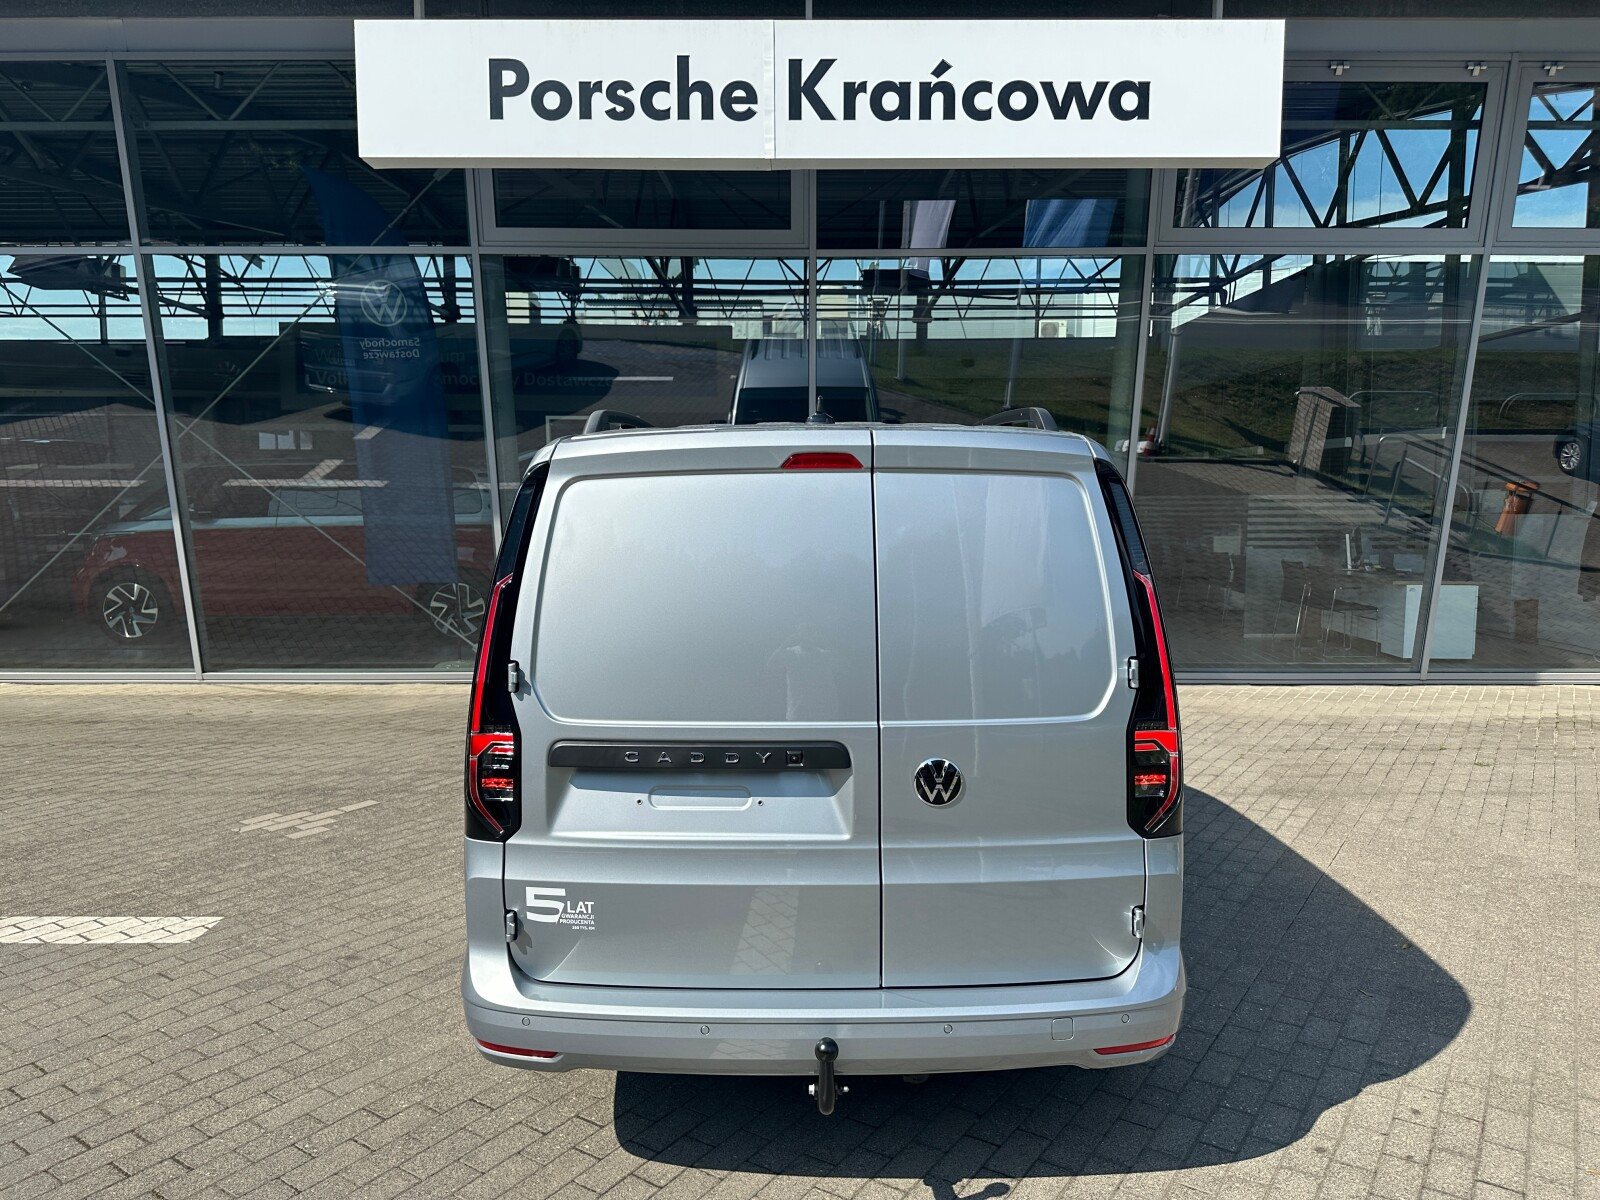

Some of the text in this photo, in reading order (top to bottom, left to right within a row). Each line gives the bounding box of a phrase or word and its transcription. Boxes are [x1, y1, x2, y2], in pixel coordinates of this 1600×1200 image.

[488, 54, 1153, 123] Porsche Krańcowa
[623, 750, 772, 765] CADDY
[525, 887, 595, 926] 5 LAT
